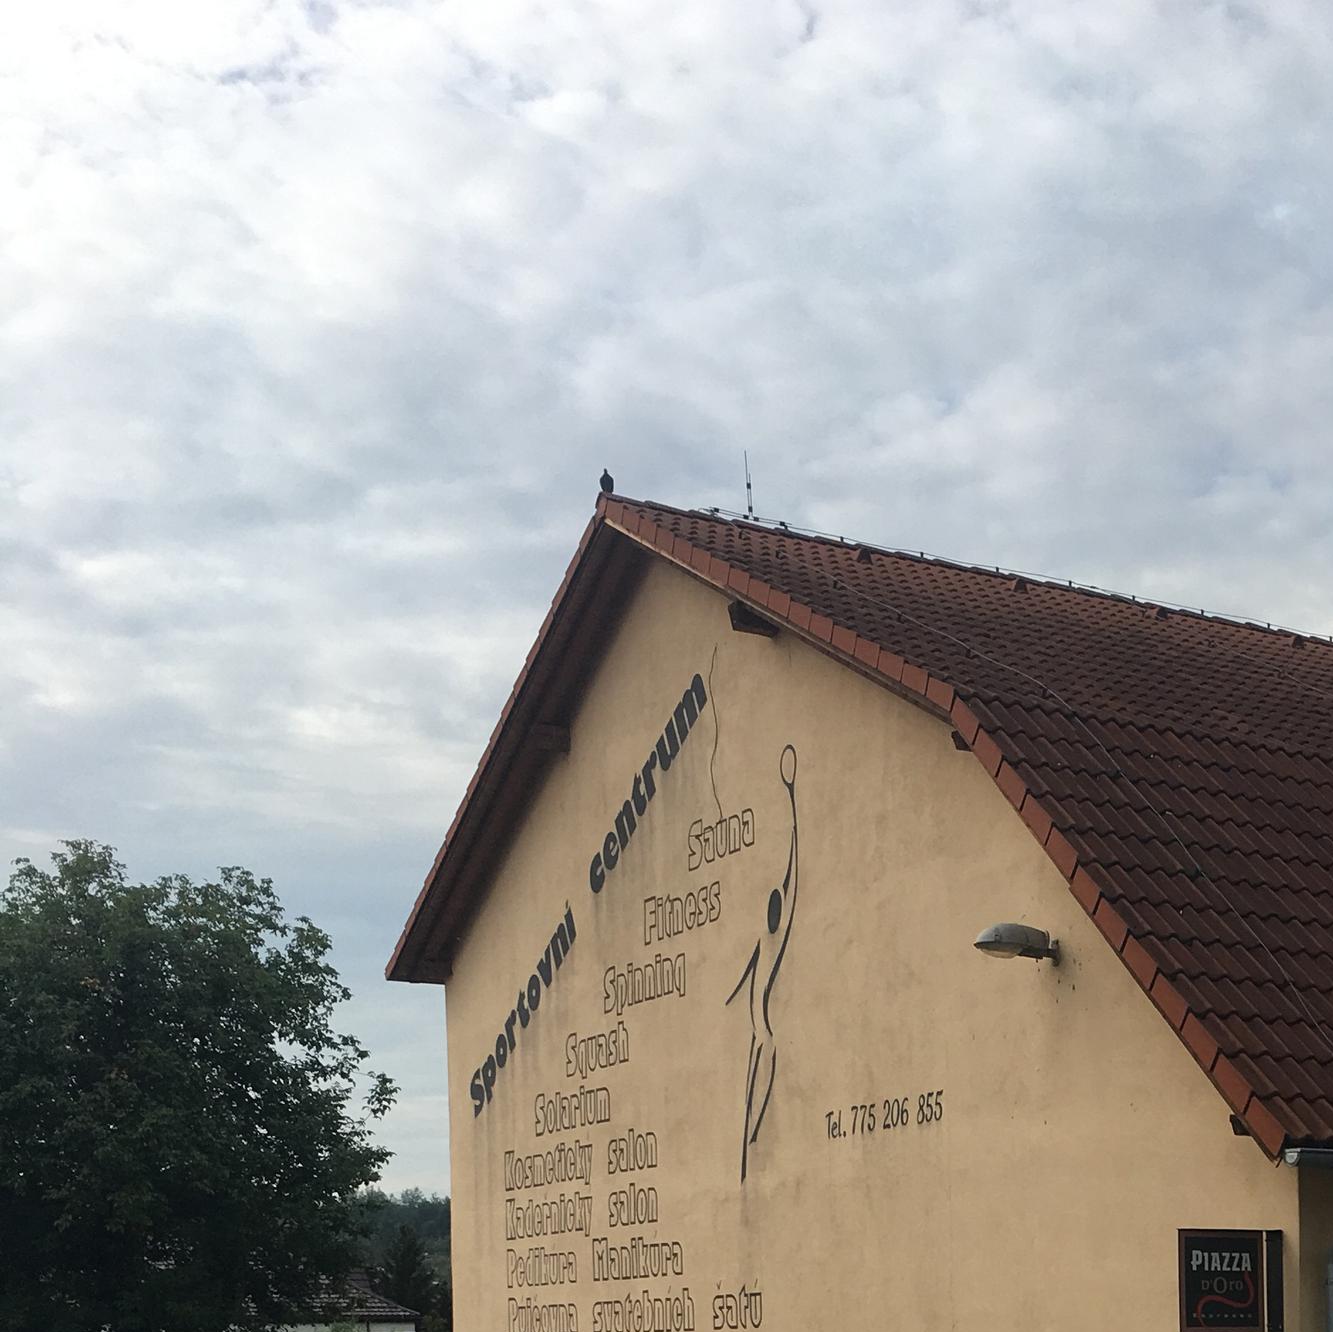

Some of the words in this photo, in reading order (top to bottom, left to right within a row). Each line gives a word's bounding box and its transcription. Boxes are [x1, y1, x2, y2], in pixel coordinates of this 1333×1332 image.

[688, 808, 755, 872] Sauna
[470, 899, 577, 1118] Sportovní
[590, 673, 708, 894] centrum
[644, 881, 721, 946] Fitness
[603, 952, 686, 1016] Spinning
[565, 1020, 629, 1079] Squash
[535, 1085, 611, 1137] Solarium
[825, 1110, 846, 1140] Tel.
[851, 1103, 876, 1135] 775
[882, 1097, 909, 1130] 206
[917, 1089, 944, 1125] 855
[608, 1128, 658, 1175] salon
[608, 1183, 659, 1228] salon
[592, 1230, 684, 1282] Manikúra
